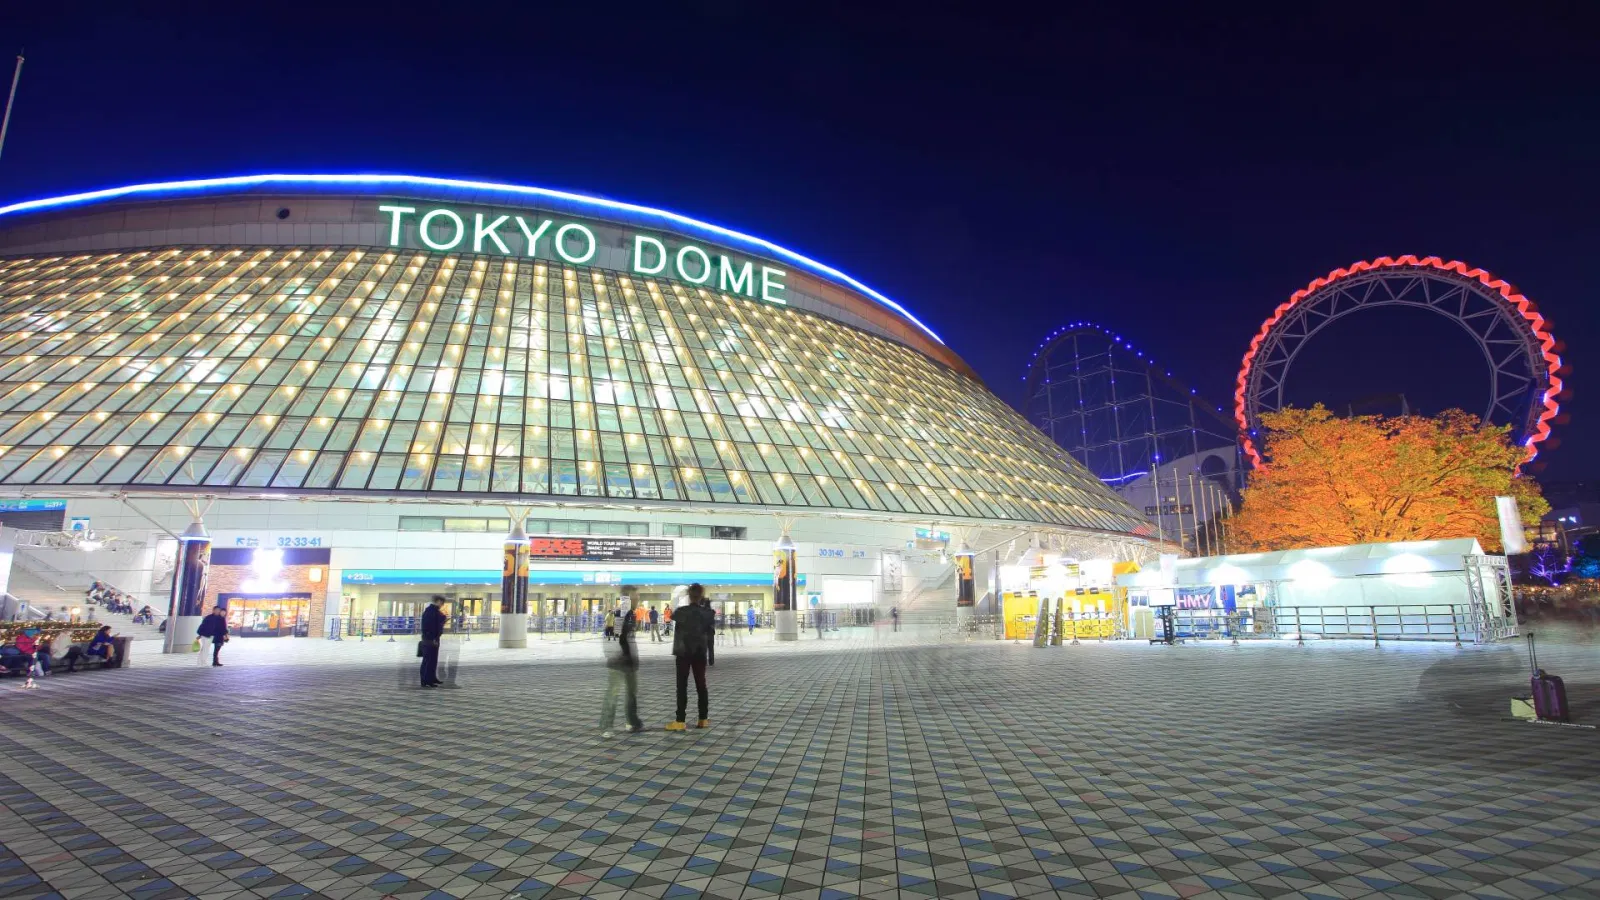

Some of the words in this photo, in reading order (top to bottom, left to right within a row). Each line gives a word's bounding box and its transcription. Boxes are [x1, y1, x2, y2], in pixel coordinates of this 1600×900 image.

[378, 204, 597, 264] TOKYO
[633, 234, 788, 306] DOME
[1177, 594, 1211, 609] HMV
